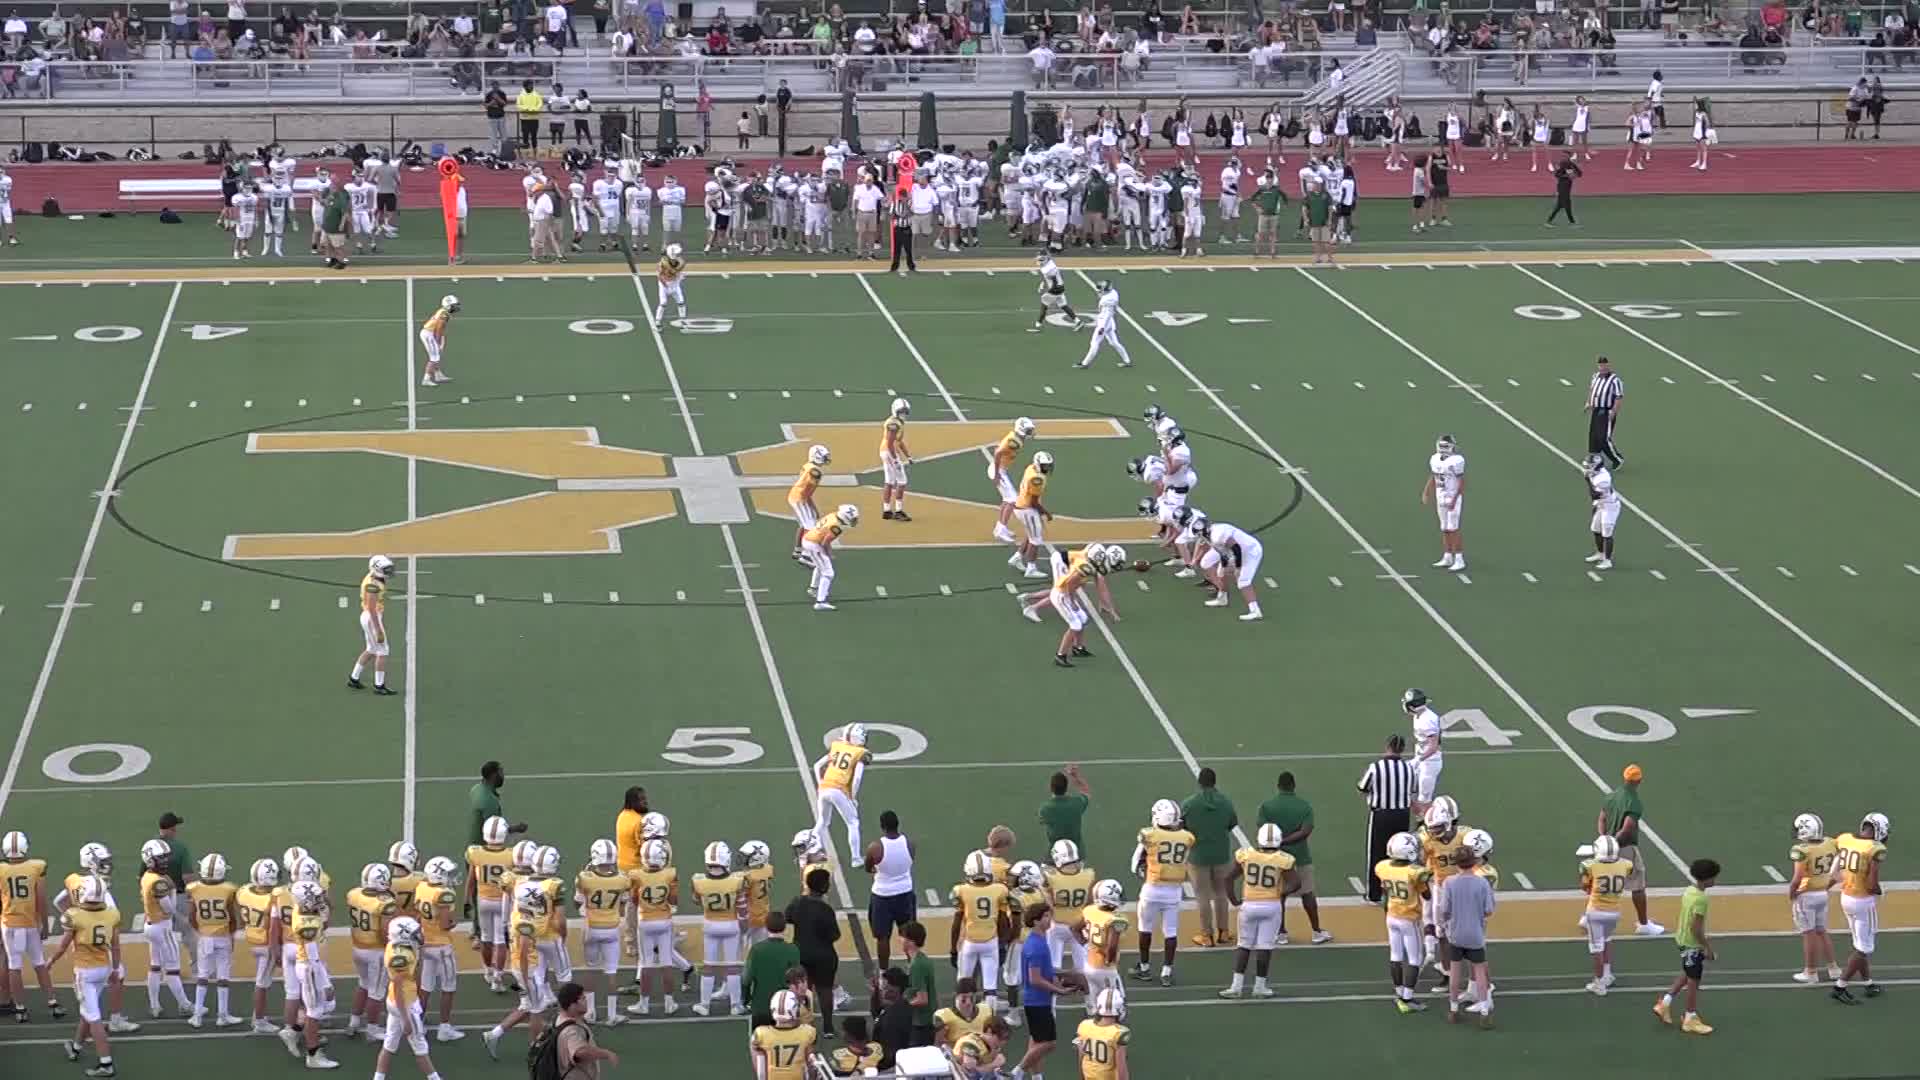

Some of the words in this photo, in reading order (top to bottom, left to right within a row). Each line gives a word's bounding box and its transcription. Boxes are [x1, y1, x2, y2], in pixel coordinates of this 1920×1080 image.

[1440, 704, 1687, 746] 40
[661, 722, 929, 766] 50
[831, 751, 853, 770] 16
[1157, 840, 1187, 865] 28
[7, 875, 29, 899] 16
[1246, 863, 1277, 888] 96
[1598, 875, 1625, 894] 30
[589, 889, 620, 909] 47
[640, 886, 668, 905] 43
[707, 893, 732, 912] 21
[198, 899, 227, 920] 85
[976, 897, 991, 919] 9
[773, 1044, 800, 1068] 17
[1082, 1038, 1107, 1064] 40
